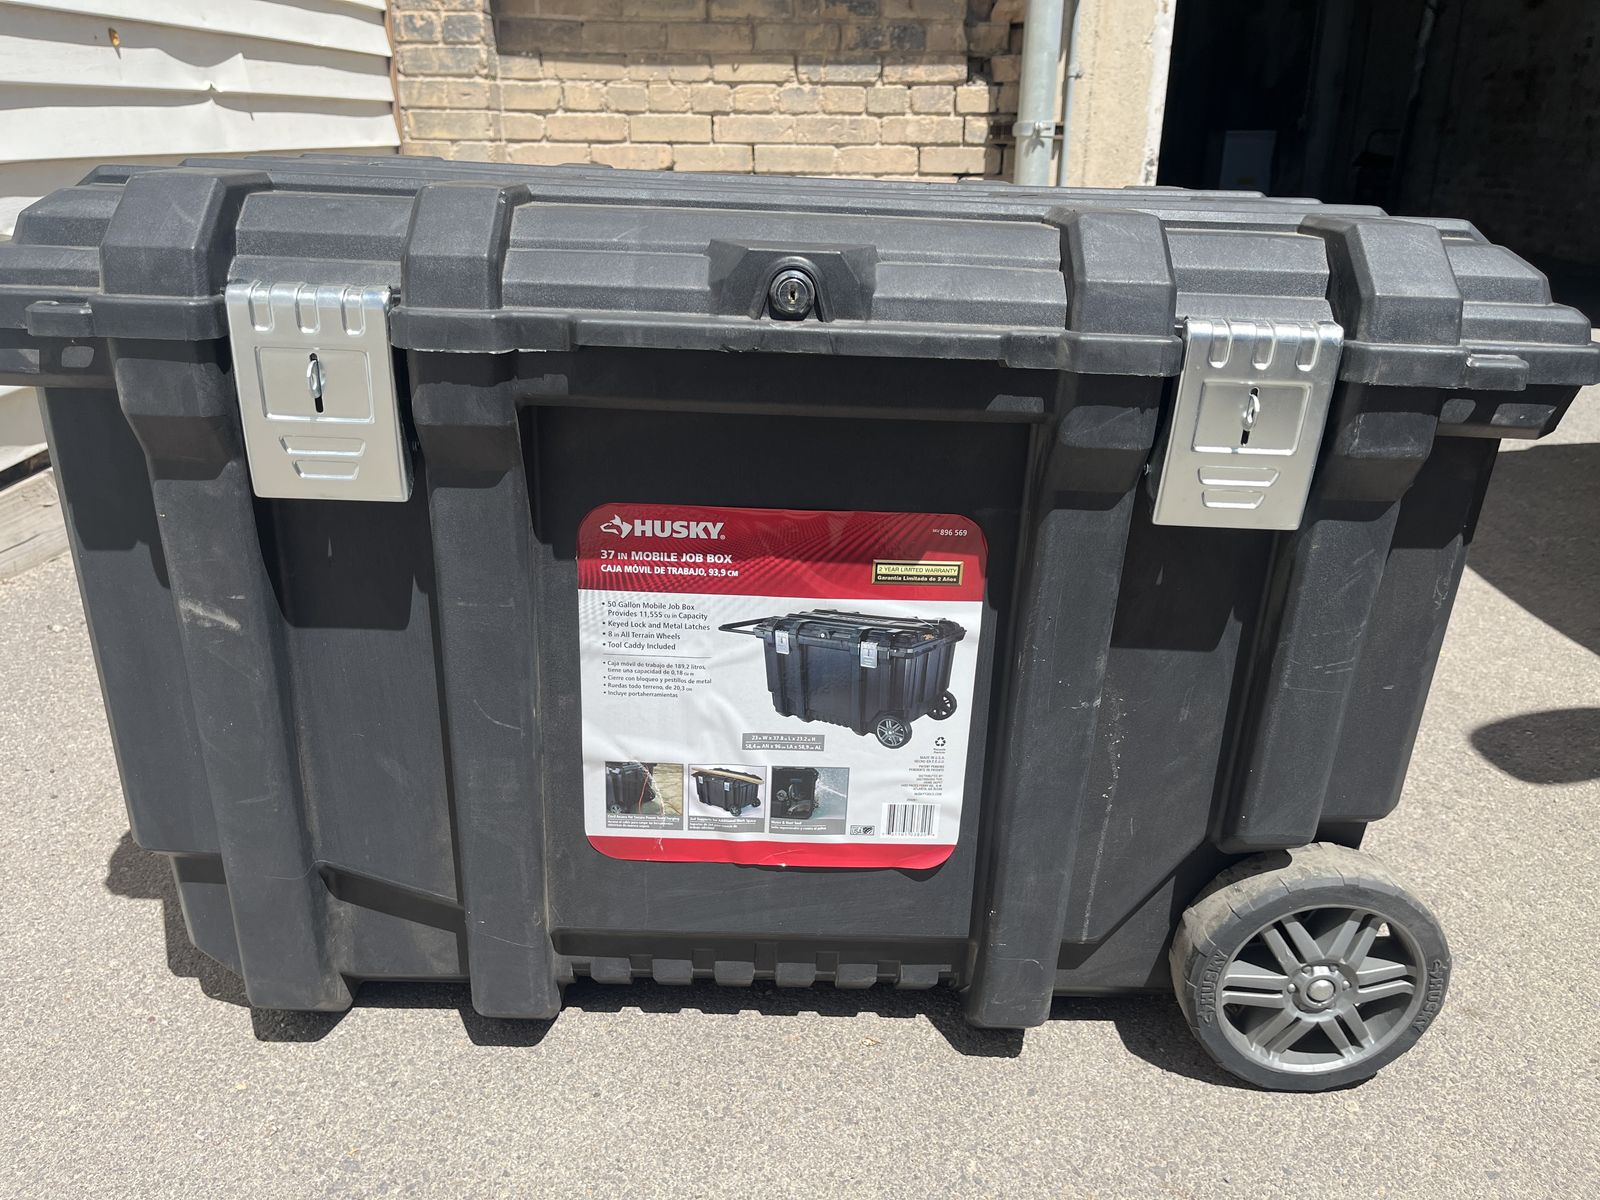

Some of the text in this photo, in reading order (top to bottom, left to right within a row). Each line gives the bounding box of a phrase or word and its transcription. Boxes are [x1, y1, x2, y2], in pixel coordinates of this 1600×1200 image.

[940, 528, 953, 536] 896
[954, 529, 968, 537] 569
[600, 550, 615, 560] 37
[631, 551, 678, 562] MOBILE
[680, 552, 704, 563] JOB
[706, 554, 732, 564] BOX
[600, 564, 622, 573] CAJA
[624, 564, 652, 574] MÓVIL
[653, 566, 665, 575] DE
[667, 567, 707, 577] TRABAJO,
[708, 568, 725, 577] 93,9
[607, 600, 617, 608] 50
[618, 601, 641, 609] Gallon
[642, 602, 667, 610] Mobile
[608, 609, 637, 617] Provides
[639, 611, 663, 619] 11,555
[678, 612, 708, 621] Capacity
[608, 621, 629, 629] Keyed
[662, 622, 683, 630] Metal
[684, 623, 710, 631] Latches
[656, 632, 681, 640] Wheels
[623, 641, 645, 650] Caddy
[646, 642, 676, 650] Included
[607, 660, 620, 668] Caja
